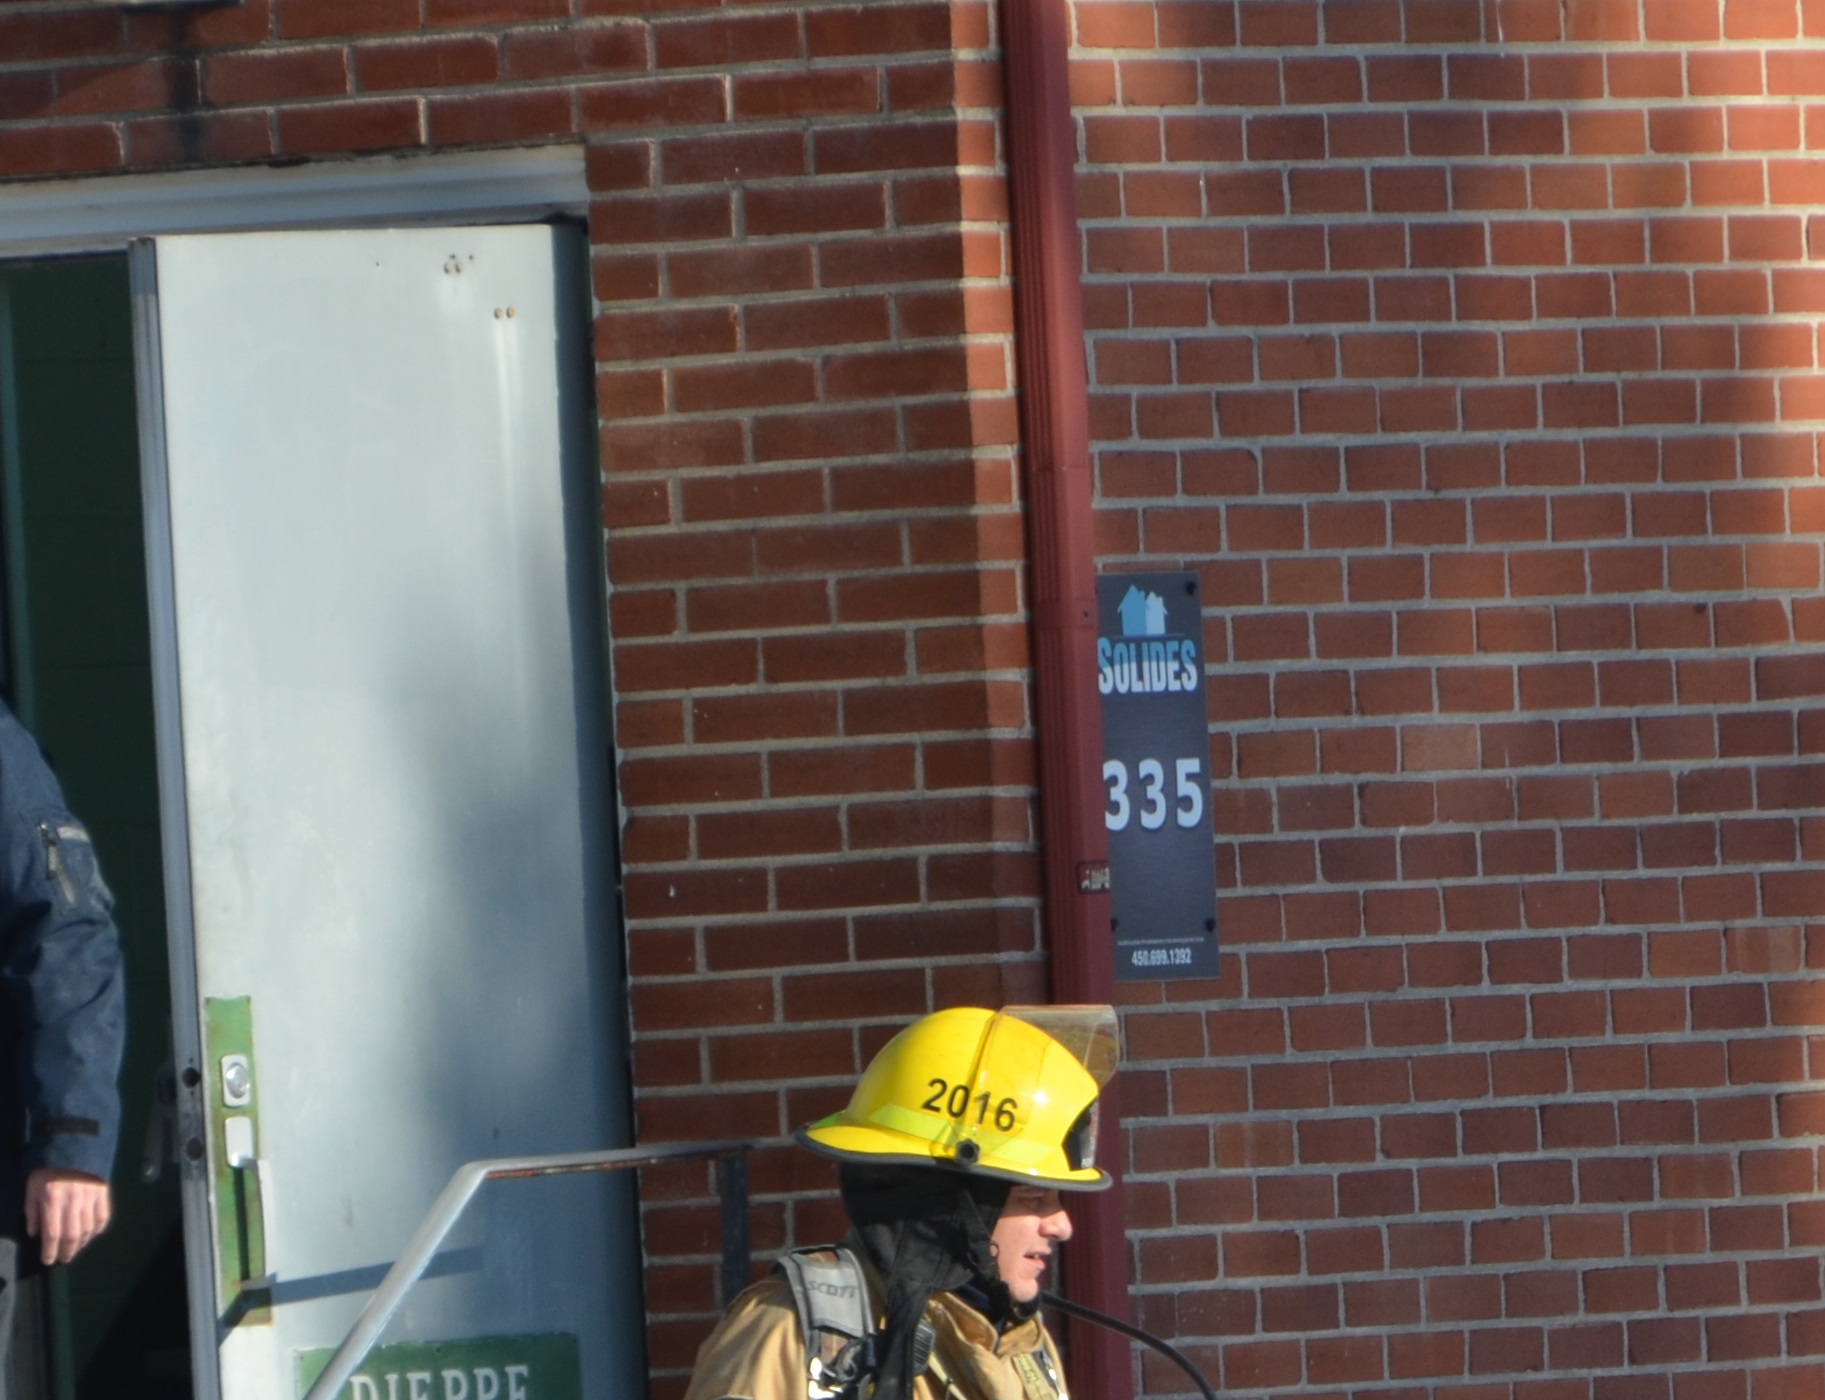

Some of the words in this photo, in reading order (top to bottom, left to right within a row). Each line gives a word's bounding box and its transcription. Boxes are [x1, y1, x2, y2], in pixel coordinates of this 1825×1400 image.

[1096, 637, 1198, 695] SOLIDES
[1102, 757, 1204, 831] 335
[921, 1078, 1018, 1132] 2016
